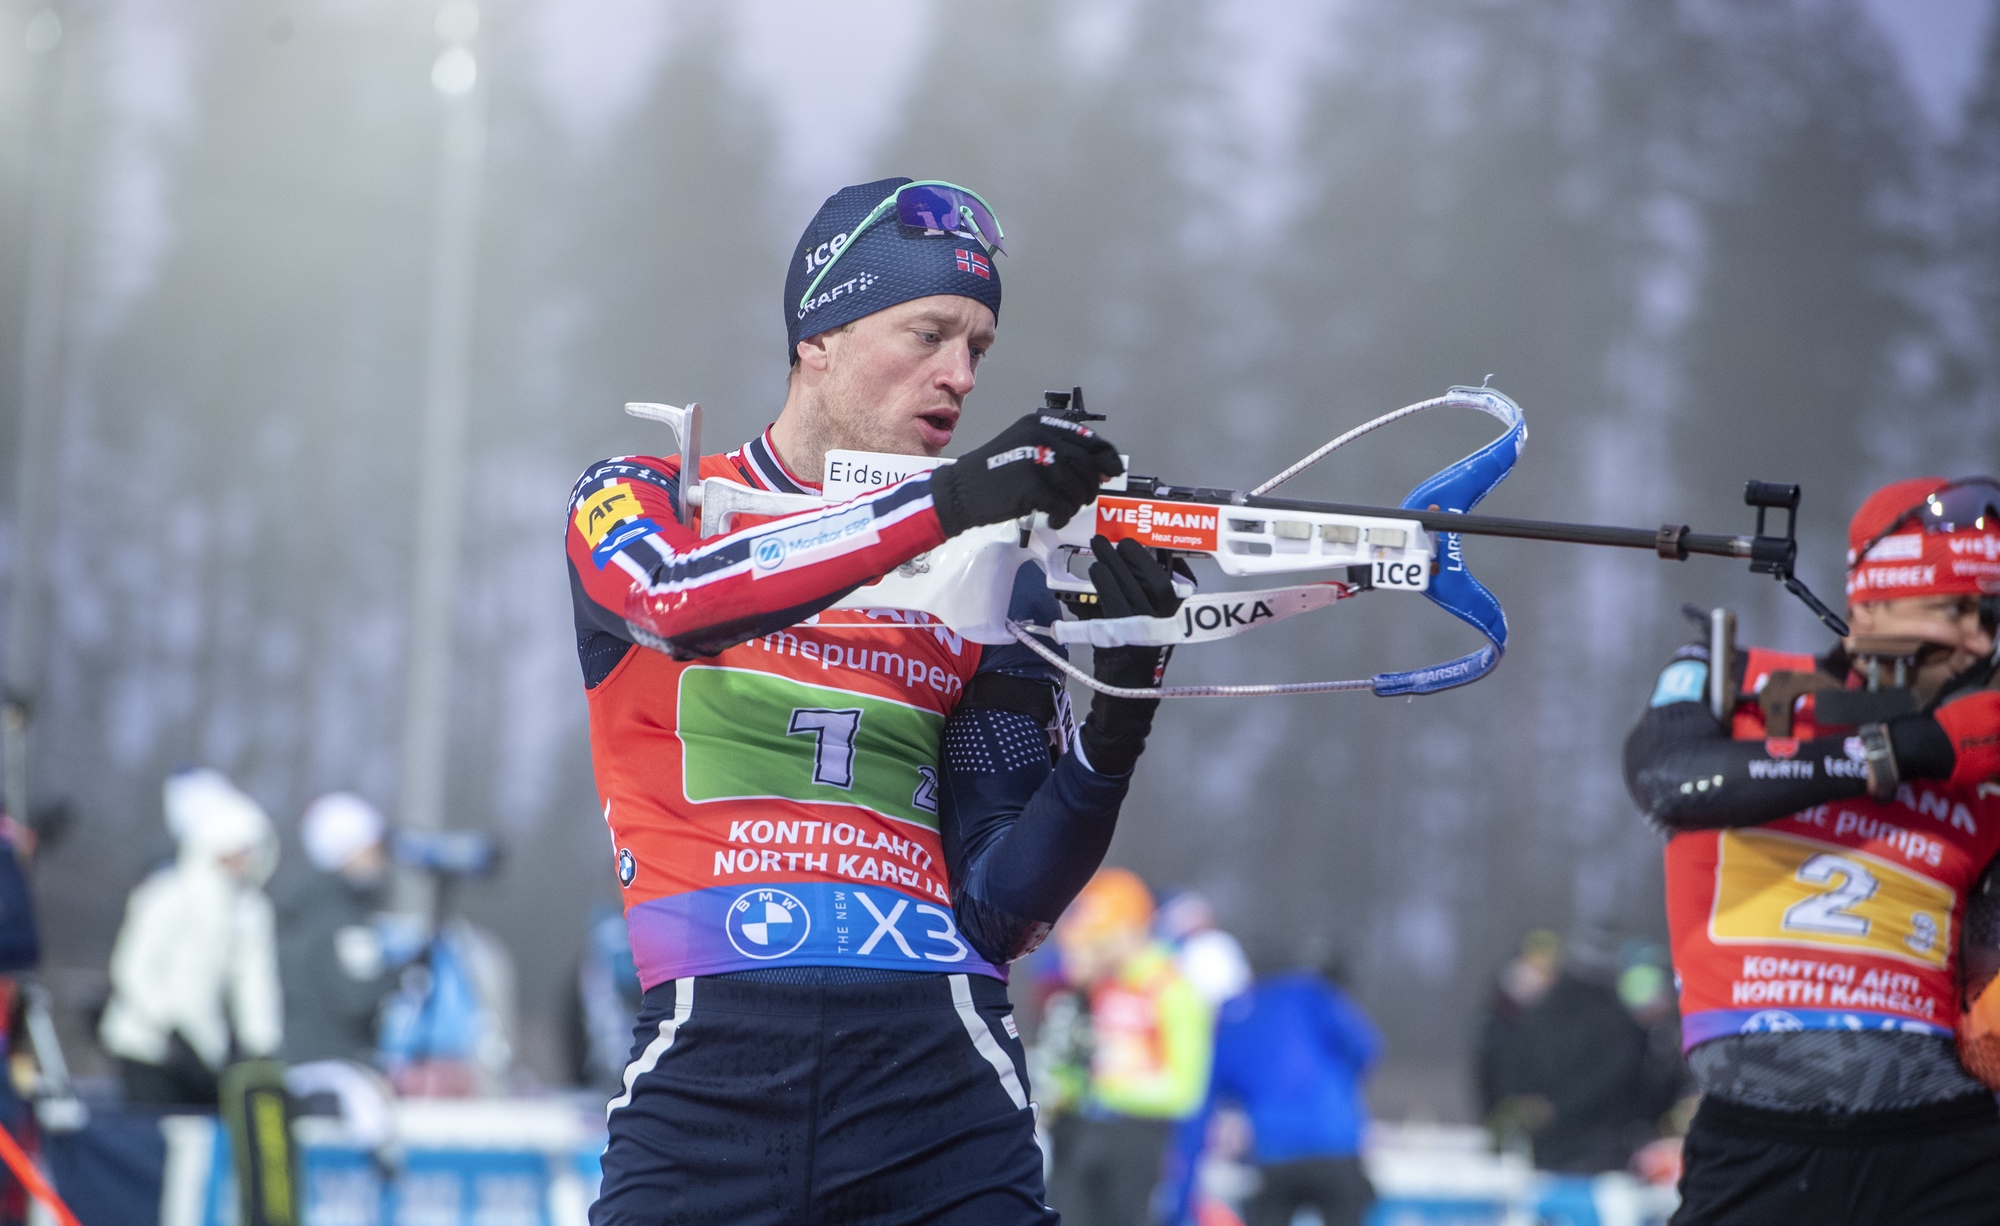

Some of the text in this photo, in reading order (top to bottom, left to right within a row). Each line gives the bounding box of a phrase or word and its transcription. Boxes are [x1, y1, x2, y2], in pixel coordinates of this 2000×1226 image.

[805, 233, 848, 274] ice
[829, 461, 907, 486] Eidsiv
[789, 516, 871, 552] Monitor ERP
[1099, 503, 1217, 534] VIESSMANN
[1151, 532, 1203, 546] Heat pumps
[1183, 600, 1275, 638] JOKA
[746, 630, 963, 697] mepumpen
[786, 706, 865, 791] 1
[912, 765, 939, 814] 2
[728, 820, 933, 871] KONTIOLAHTI
[1835, 810, 1944, 867] pumps
[713, 849, 952, 905] NORTH KARELIA
[1780, 853, 1880, 938] 2
[834, 890, 849, 954] THE NEW
[853, 891, 968, 963] X3
[1732, 980, 1825, 1005] NORTH
